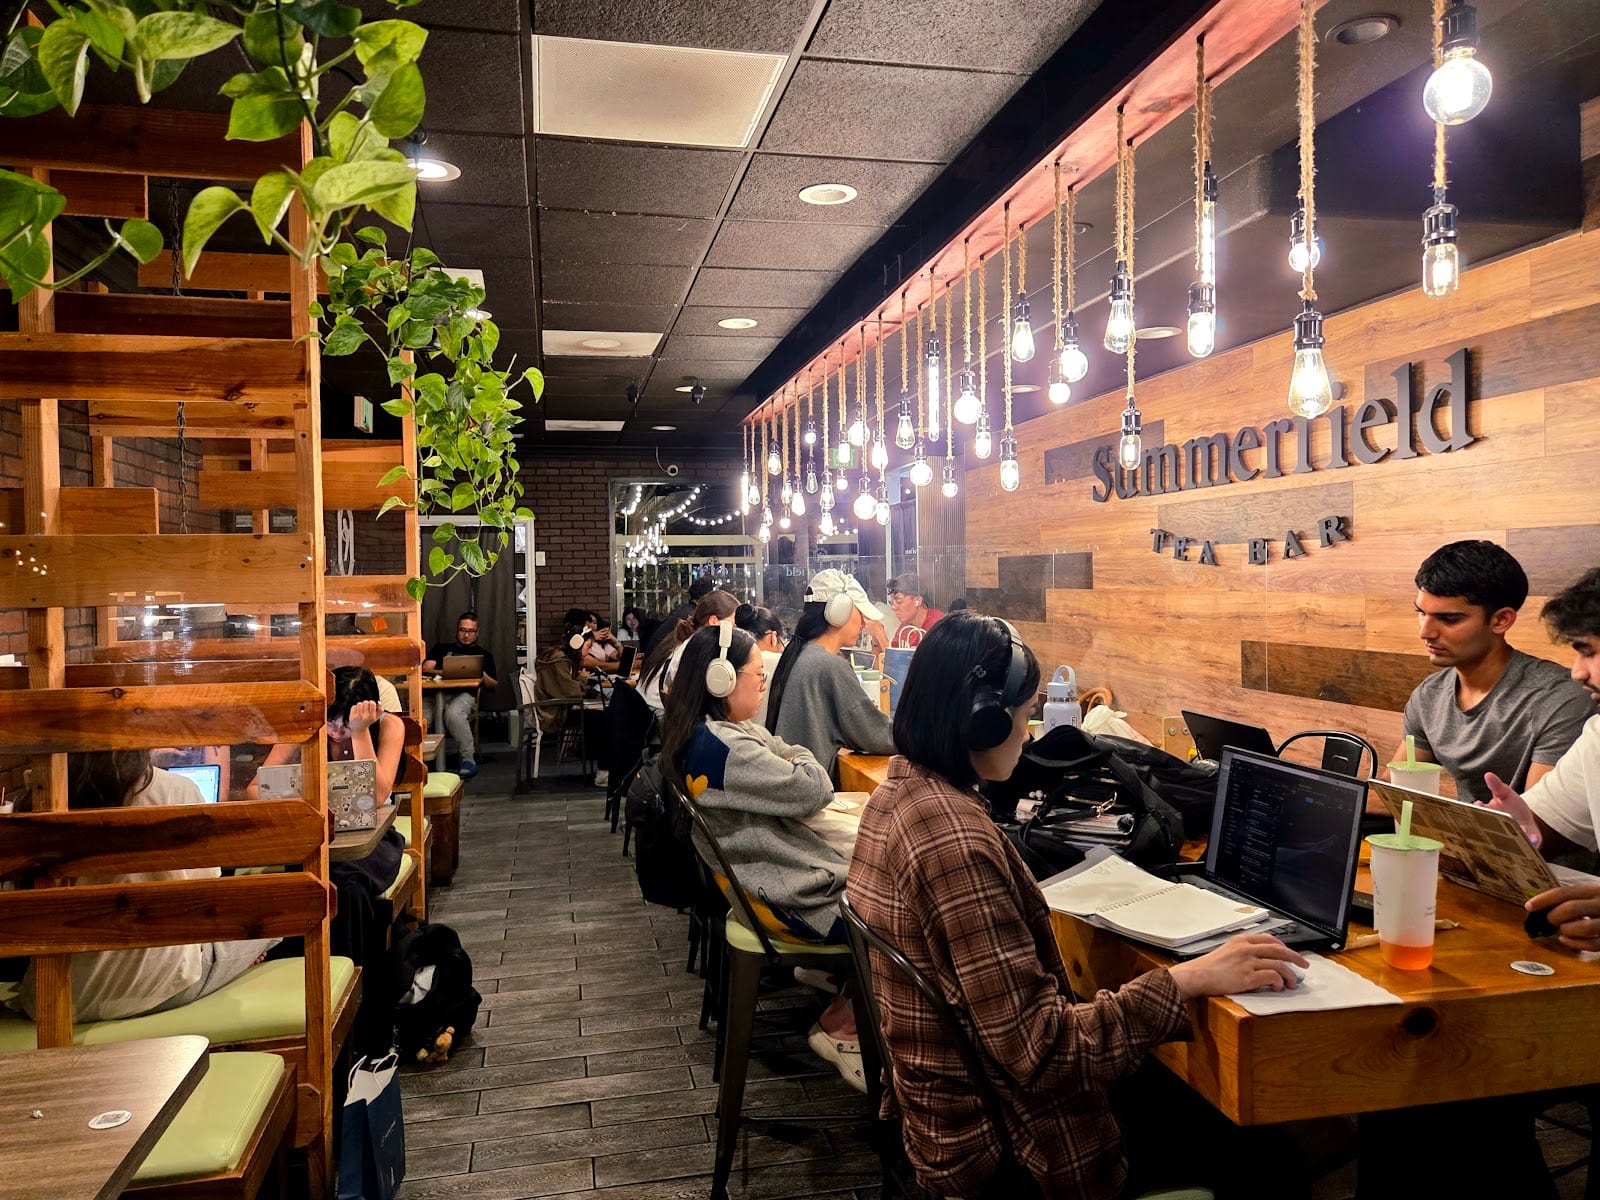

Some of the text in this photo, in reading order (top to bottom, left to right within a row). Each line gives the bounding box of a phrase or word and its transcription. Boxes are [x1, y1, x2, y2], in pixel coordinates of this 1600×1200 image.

[832, 448, 855, 467] ET
[1150, 515, 1350, 566] TEA BAR
